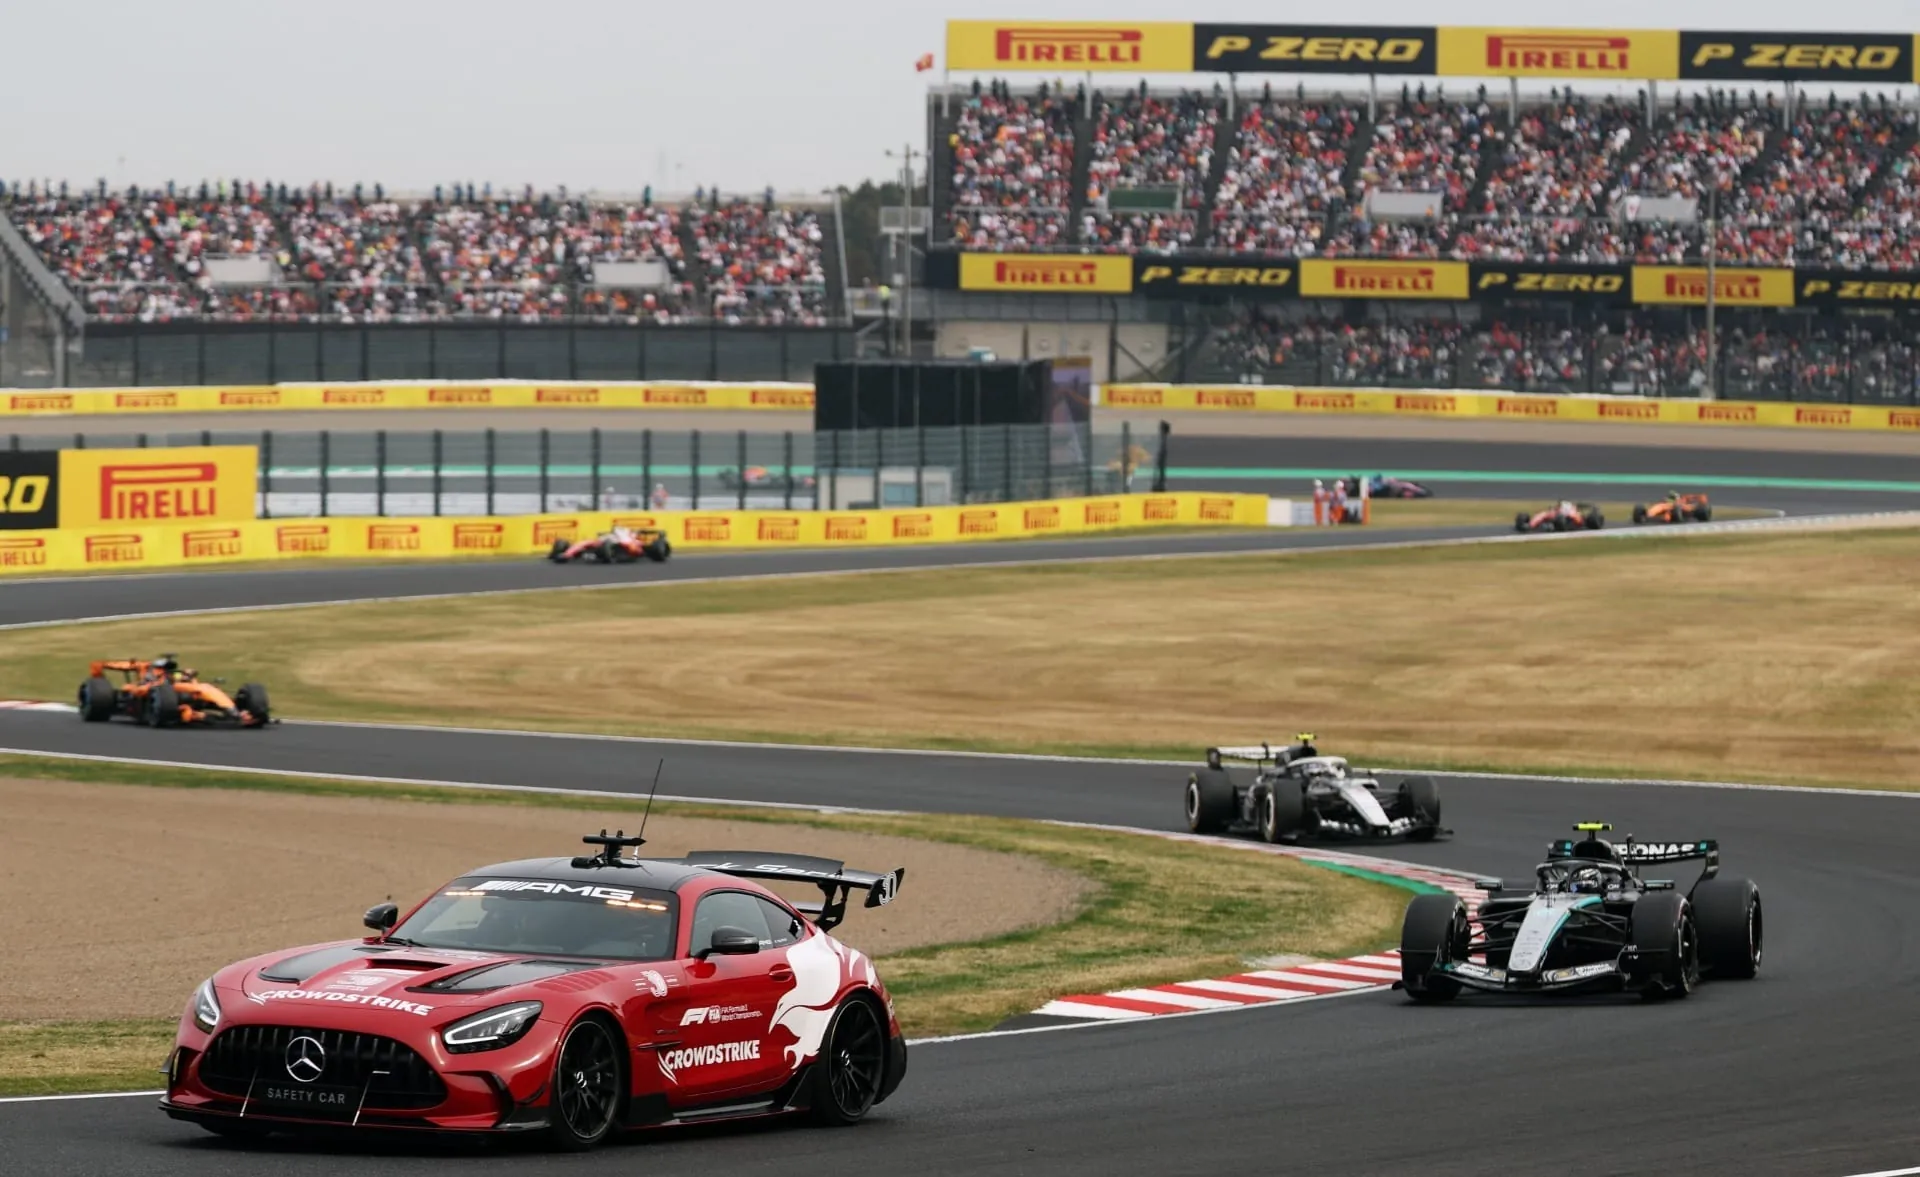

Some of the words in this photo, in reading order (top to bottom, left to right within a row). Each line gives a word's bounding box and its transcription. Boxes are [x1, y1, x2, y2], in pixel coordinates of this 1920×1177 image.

[995, 28, 1143, 62] PIRELLI
[1207, 35, 1250, 59] P
[1260, 36, 1424, 62] ZERO
[1486, 35, 1630, 70] PIRELLI
[1693, 44, 1734, 67] P
[1744, 45, 1899, 69] ZERO
[995, 260, 1096, 285] PIRELLI
[1141, 266, 1171, 284] P
[1178, 267, 1291, 286] ZERO
[1334, 267, 1434, 291] PIRELLI
[1478, 273, 1507, 290] P
[1514, 274, 1623, 292] ZERO
[1665, 273, 1761, 299] PIRELLI
[1803, 281, 1831, 298] P
[11, 395, 73, 409] PIRELLI
[116, 393, 176, 407] PIRELLI
[221, 391, 280, 405] PIRELLI
[323, 389, 383, 403] PIRELLI
[428, 389, 491, 403] PIRELLI
[536, 389, 599, 403] PIRELLI
[643, 389, 706, 404] PIRELLI
[1108, 389, 1163, 405] PIRELLI
[1197, 390, 1255, 407] PIRELLI
[1295, 392, 1354, 408] PIRELLI
[1395, 395, 1455, 411] PIRELLI
[1497, 399, 1556, 416] PIRELLI
[1598, 402, 1659, 418] PIRELLI
[1699, 405, 1756, 421] PIRELLI
[1796, 409, 1851, 424] PIRELLI
[99, 462, 218, 520] PIRELLI
[1024, 507, 1060, 530] PIRELLI
[1085, 502, 1120, 525] PIRELLI
[1143, 499, 1178, 521] PIRELLI
[1200, 499, 1234, 520] PIRELLI
[684, 517, 731, 540] PIRELLI
[758, 518, 799, 540] PIRELLI
[825, 517, 867, 540] PIRELLI
[893, 514, 931, 538] PIRELLI
[959, 510, 997, 535] PIRELLI
[182, 529, 241, 558] PIRELLI
[277, 525, 329, 552] PIRELLI
[368, 525, 420, 550] PIRELLI
[454, 523, 503, 548] PIRELLI
[85, 534, 143, 562] PIRELLI
[516, 882, 634, 901] AMG
[263, 989, 434, 1017] CROWDSTRIKE
[665, 1039, 761, 1070] CROWDSTRIKE
[267, 1087, 313, 1102] SAFETY
[319, 1092, 346, 1105] CAR
